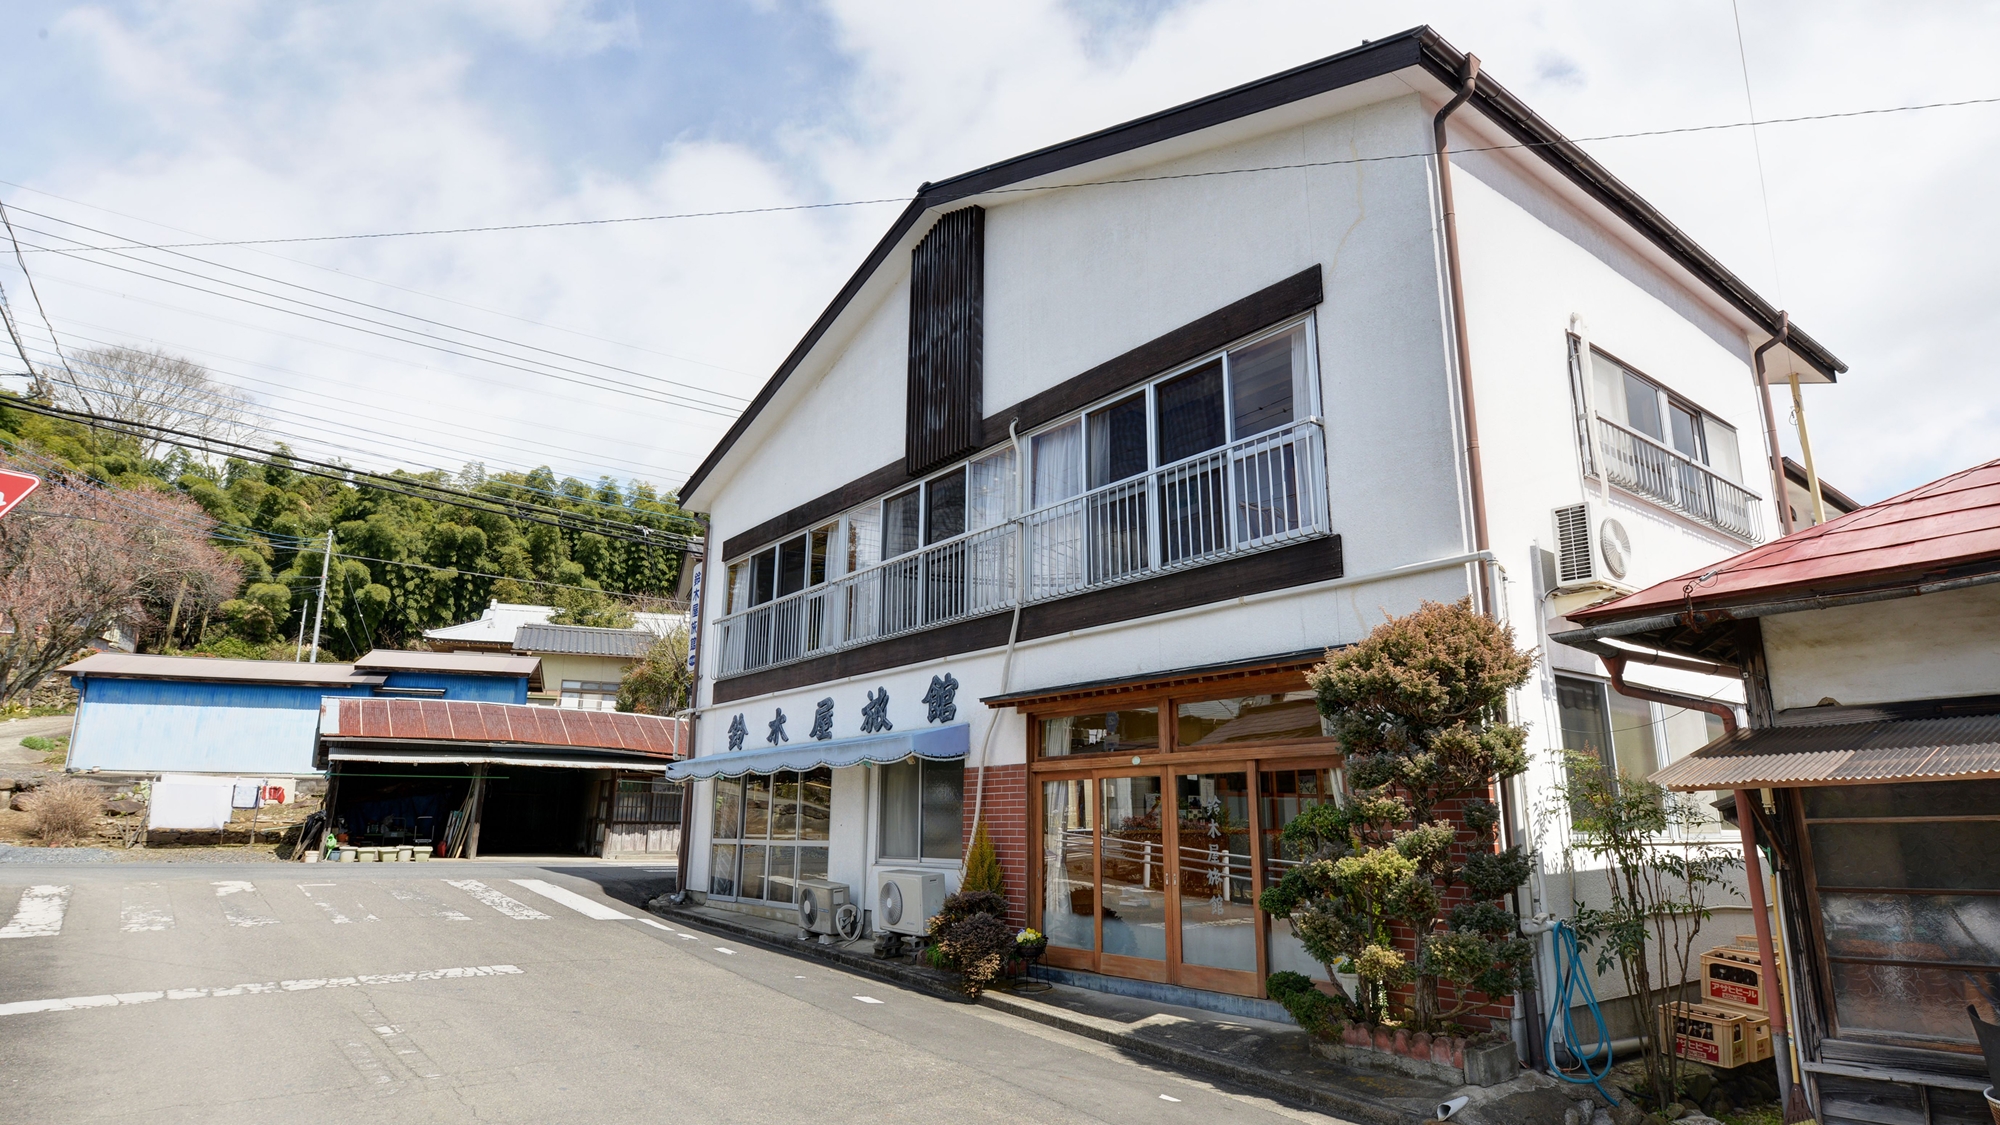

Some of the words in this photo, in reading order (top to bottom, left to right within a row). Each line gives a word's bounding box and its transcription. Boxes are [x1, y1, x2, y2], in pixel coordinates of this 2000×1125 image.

[727, 672, 959, 751] 鈴木屋旅館
[1206, 795, 1224, 916] 鈴木屋旅館
[1711, 982, 1757, 998] アサヒビール
